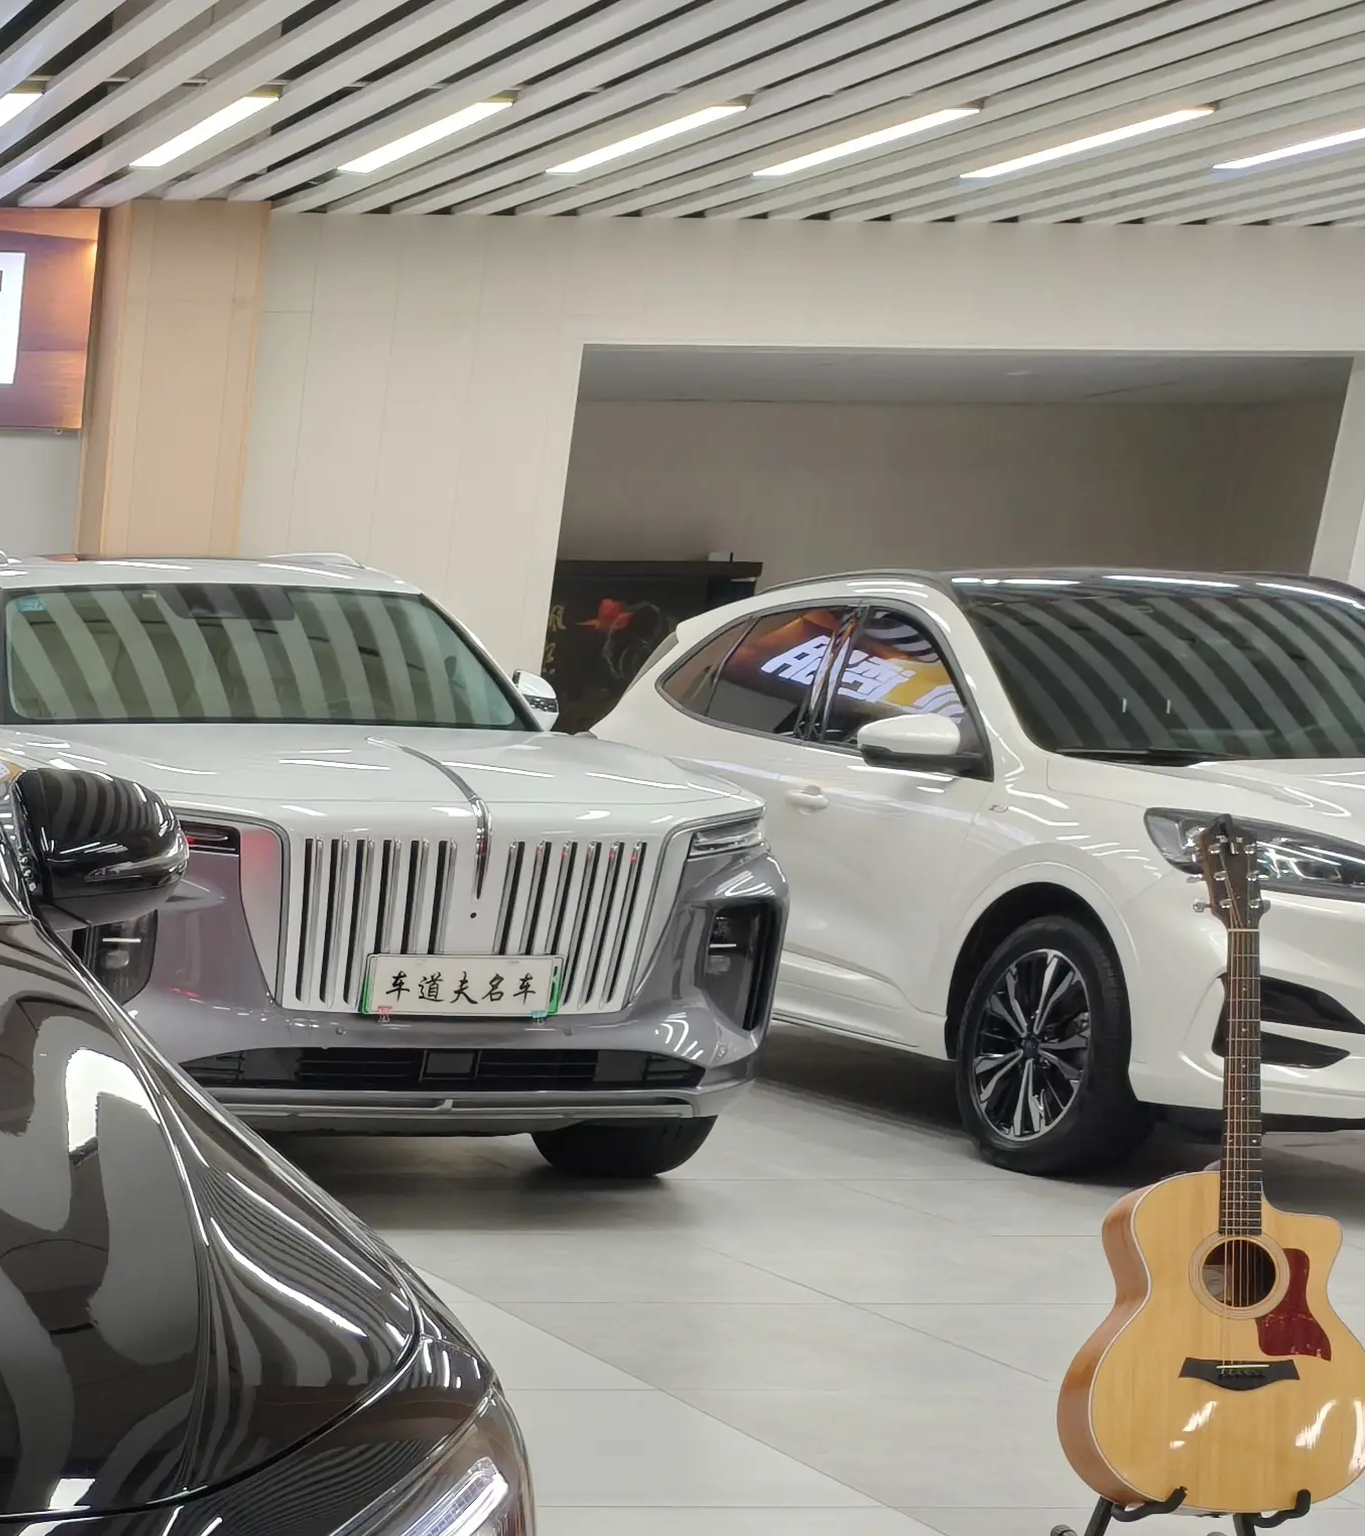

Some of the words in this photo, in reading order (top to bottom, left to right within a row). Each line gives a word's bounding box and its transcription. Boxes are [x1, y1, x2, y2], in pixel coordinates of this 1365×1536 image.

[385, 970, 537, 1005] 车道夫名车
